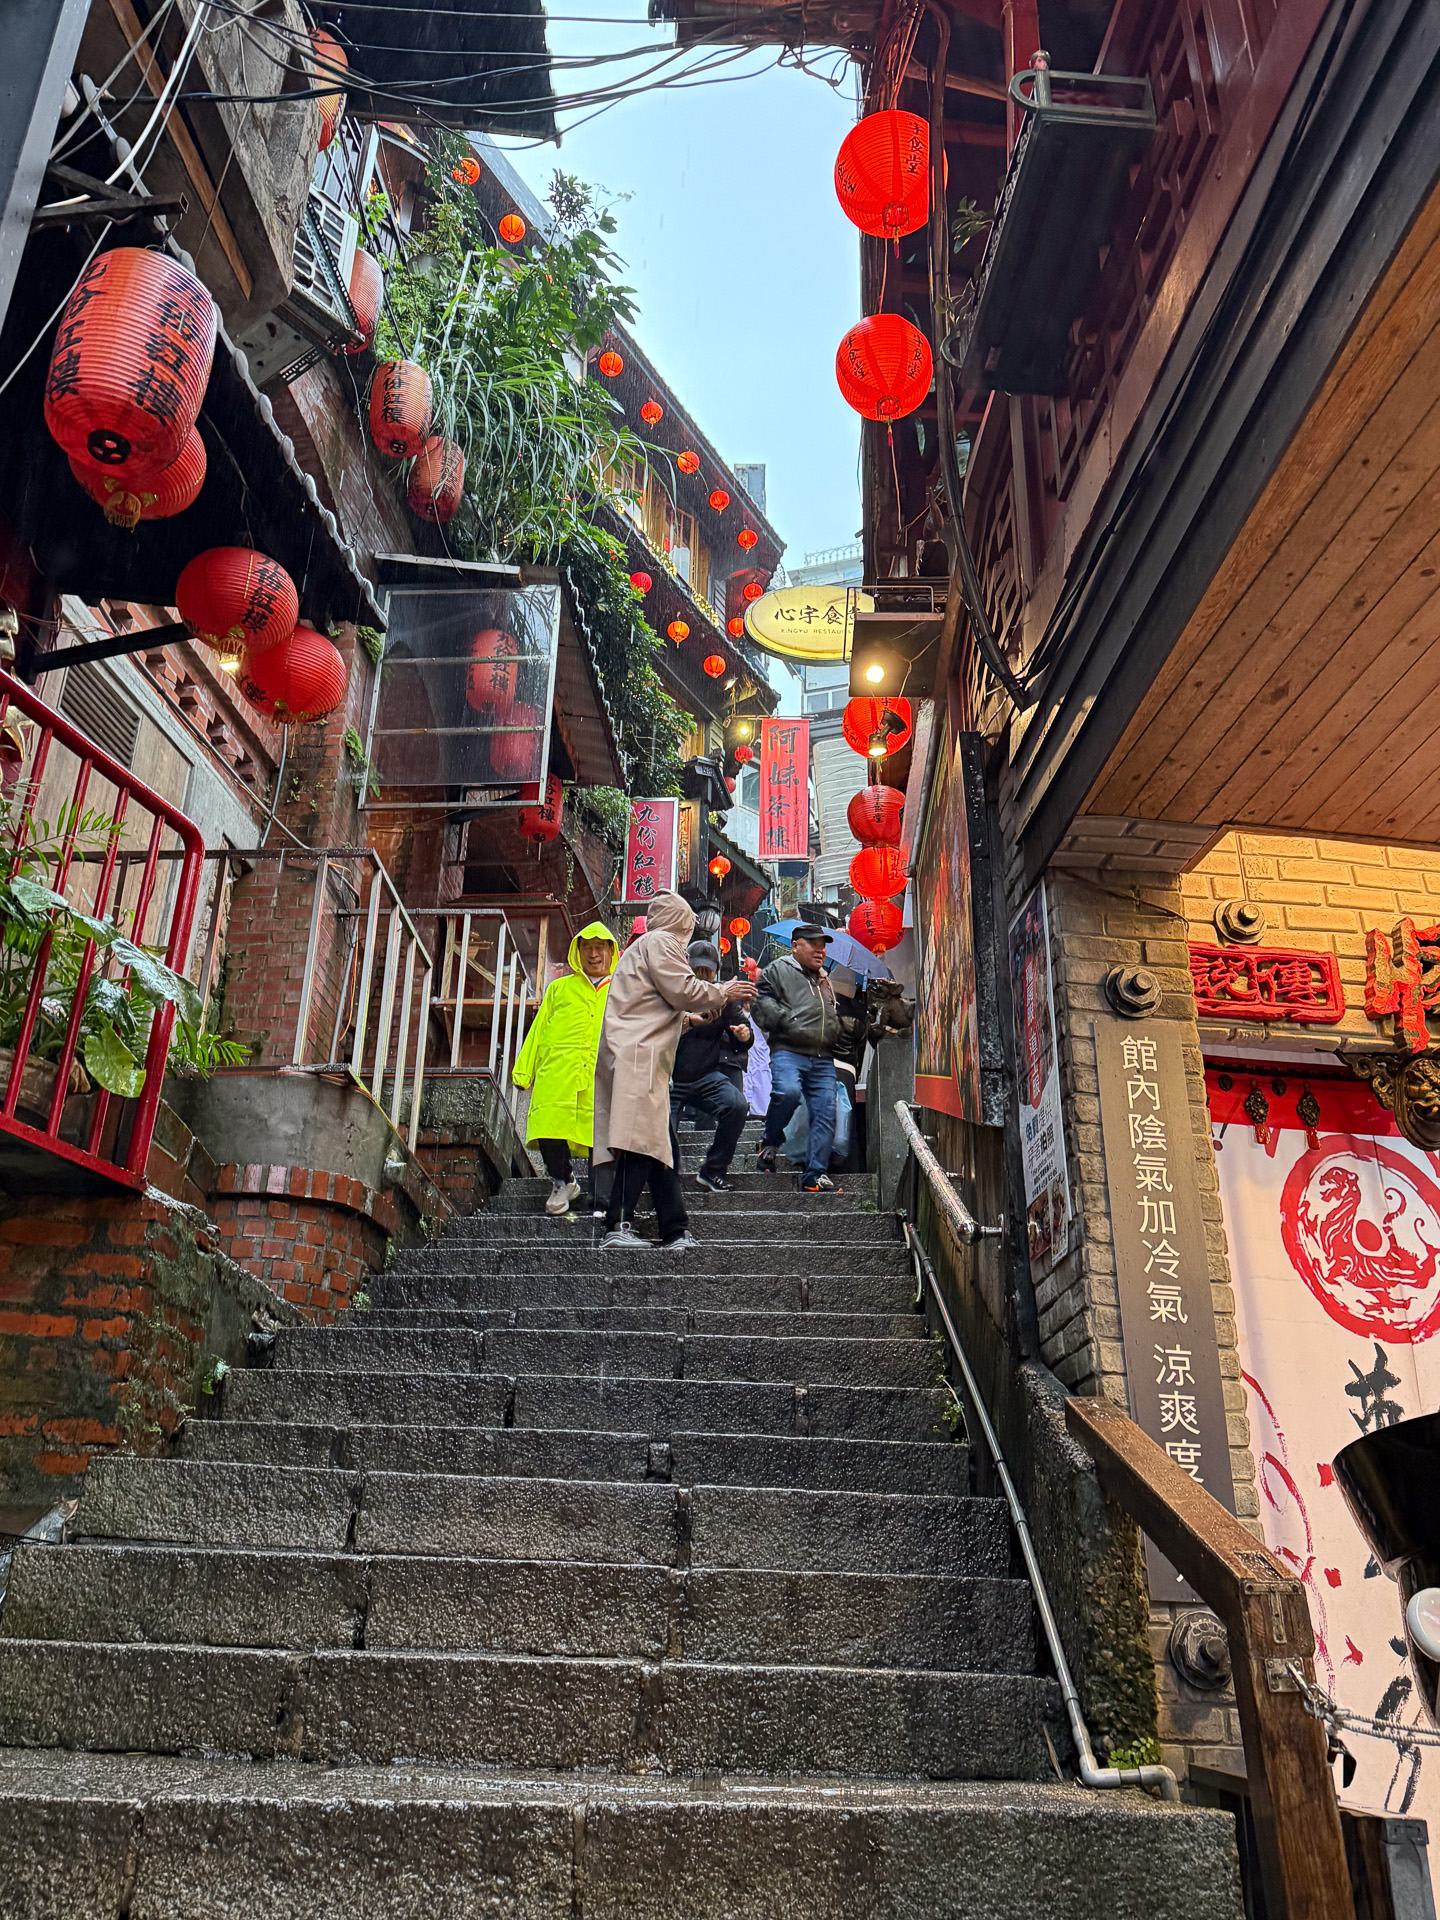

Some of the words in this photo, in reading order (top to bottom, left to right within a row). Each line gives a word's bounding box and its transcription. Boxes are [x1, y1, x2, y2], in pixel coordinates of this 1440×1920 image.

[239, 556, 286, 635] 九份紅樓
[764, 725, 801, 850] 阿妹茶樓
[632, 804, 660, 897] 九份紅樓
